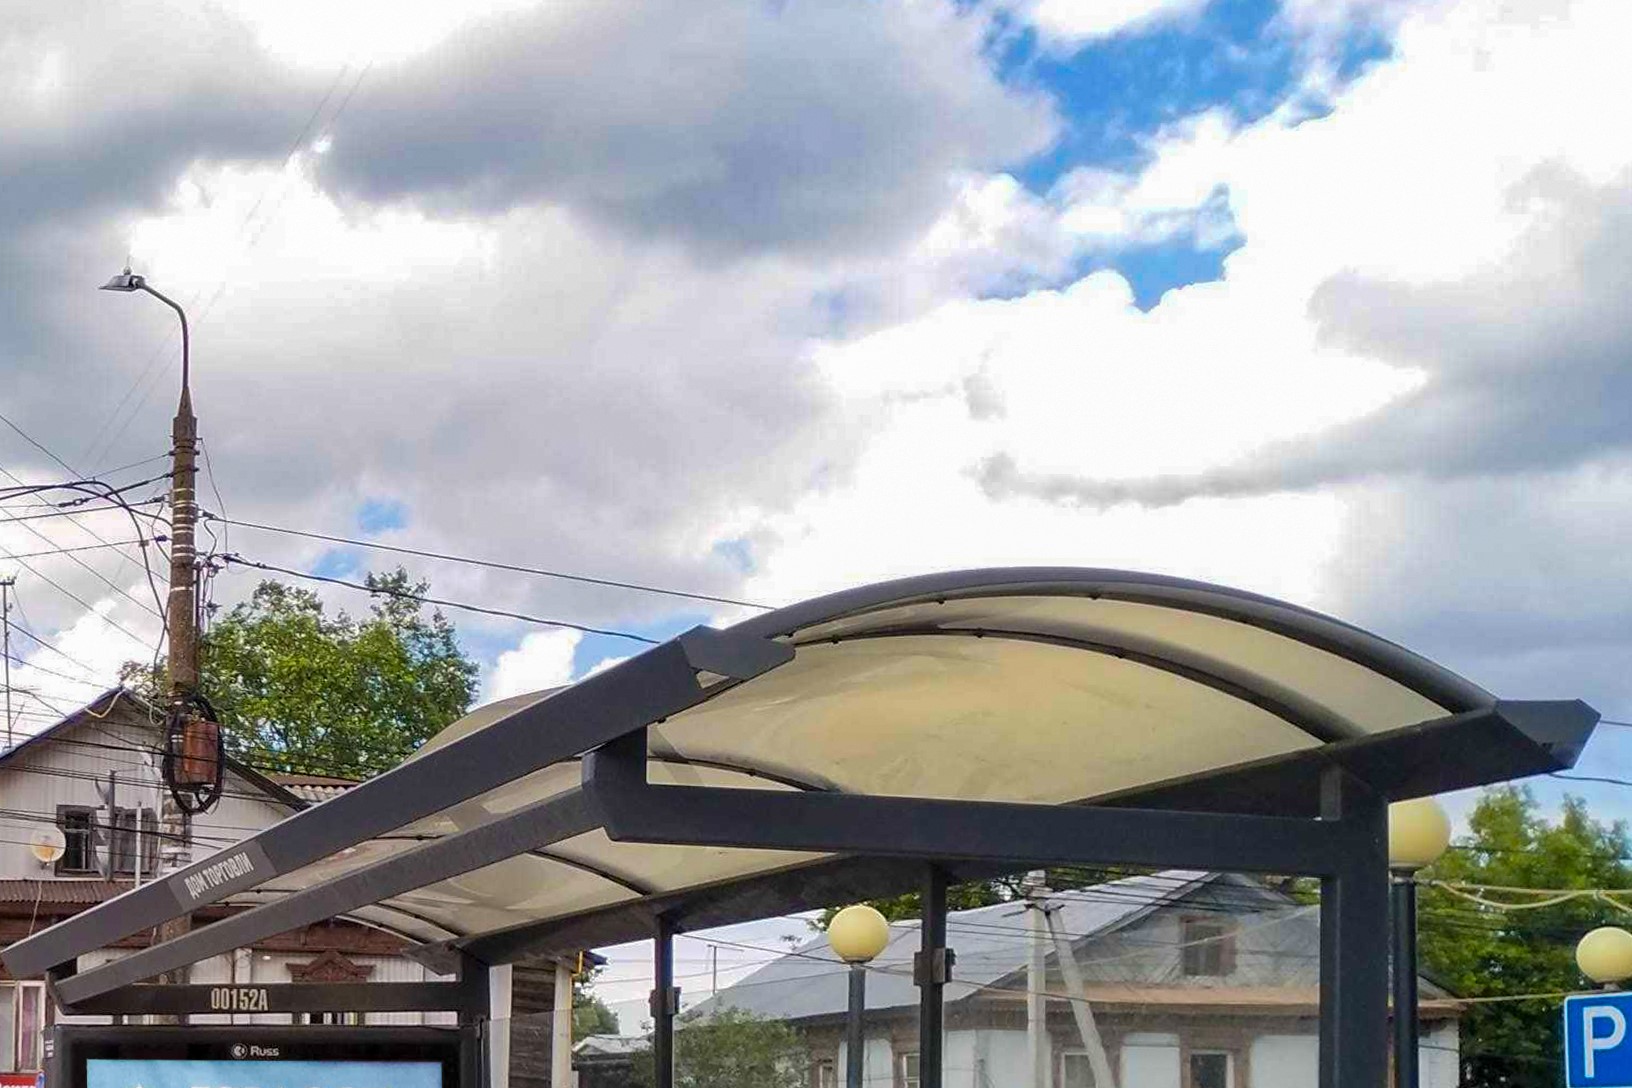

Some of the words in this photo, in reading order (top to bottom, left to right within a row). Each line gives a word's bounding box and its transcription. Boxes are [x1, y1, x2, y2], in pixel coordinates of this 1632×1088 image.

[184, 871, 210, 900] ДОМ
[202, 851, 255, 888] ТОРГОВЛИ
[210, 987, 269, 1011] 00152A
[1583, 1005, 1627, 1079] P
